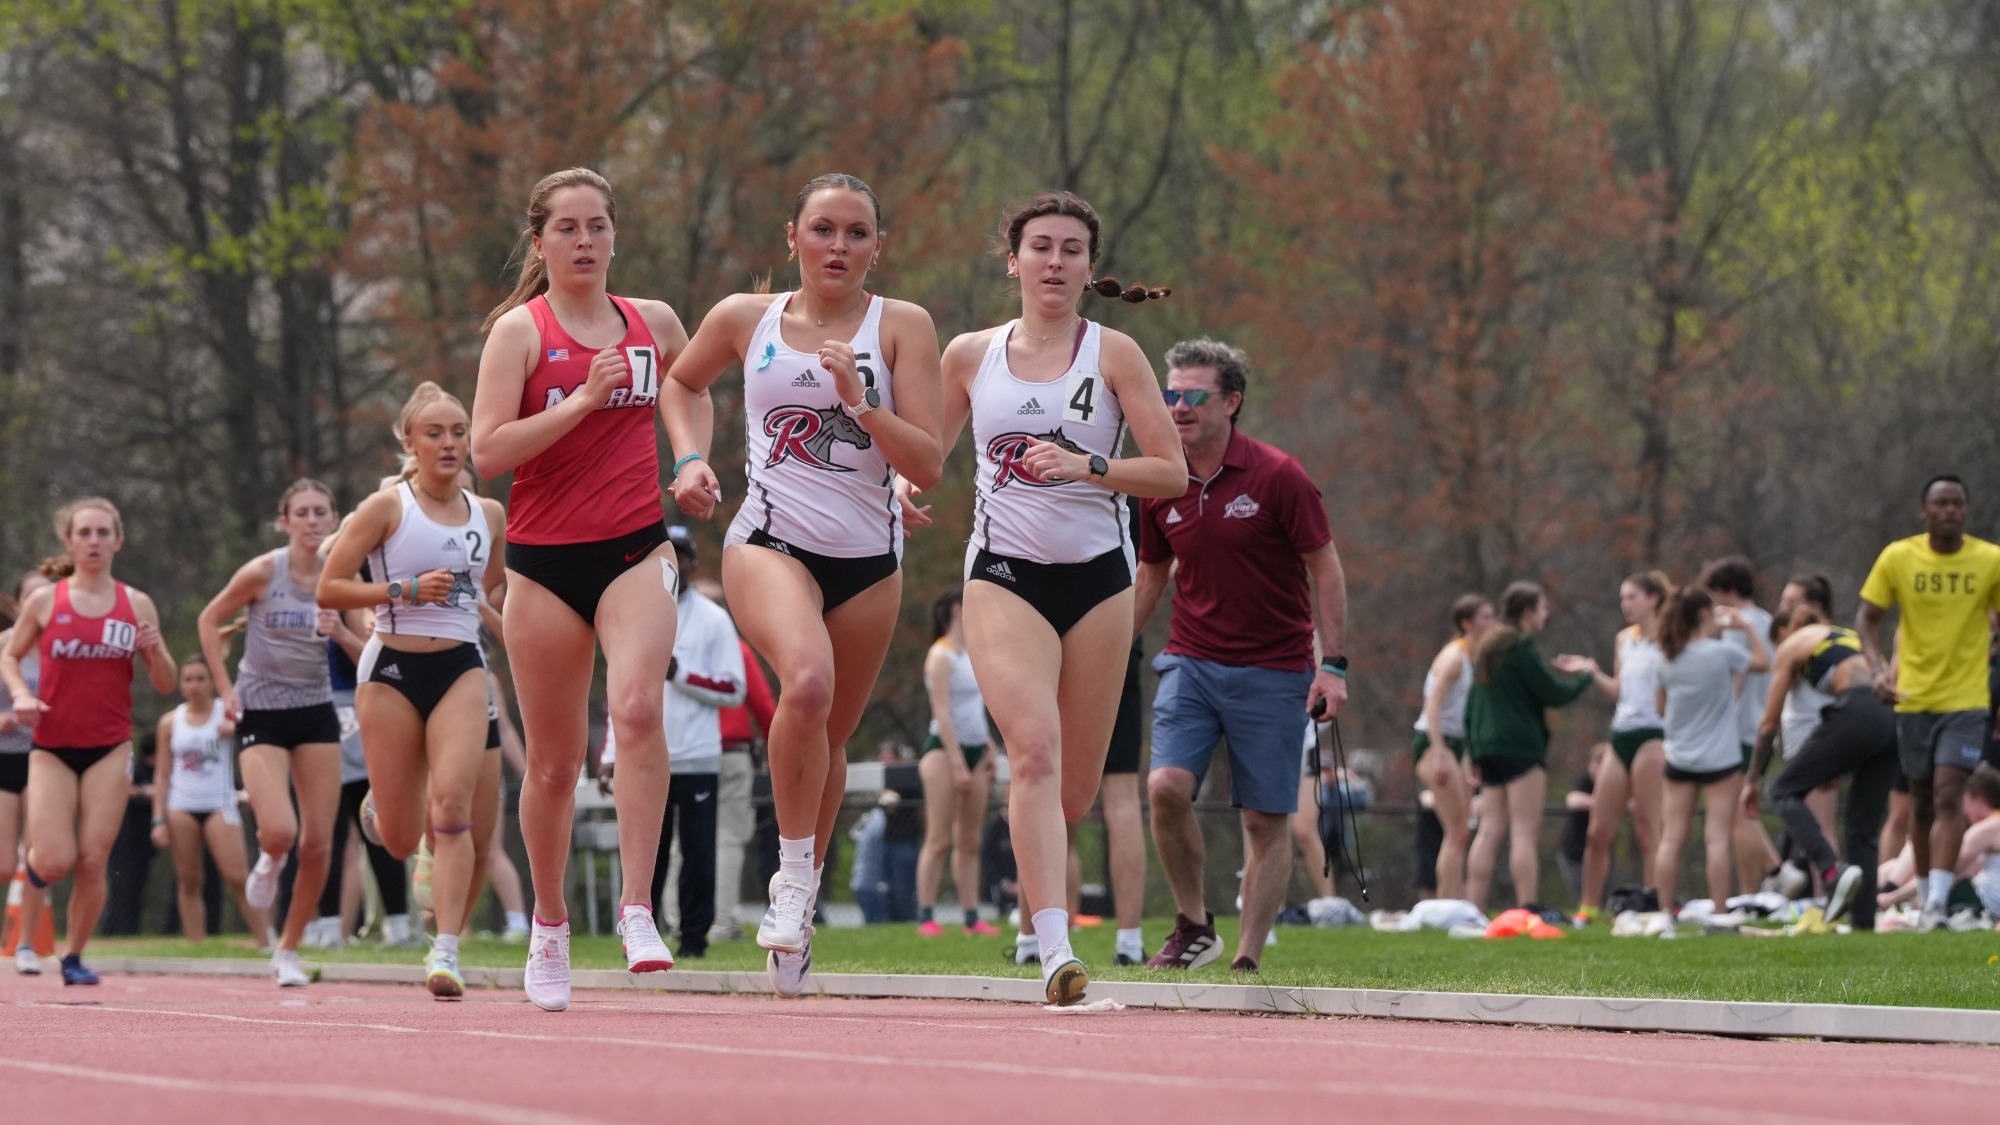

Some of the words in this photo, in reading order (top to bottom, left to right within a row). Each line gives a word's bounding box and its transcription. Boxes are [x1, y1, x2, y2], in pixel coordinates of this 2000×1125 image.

[634, 350, 652, 393] 7
[791, 380, 821, 388] adidas
[1069, 377, 1095, 421] 4
[1017, 407, 1045, 415] adidas
[466, 530, 482, 562] 2
[986, 566, 1017, 583] adidas
[1914, 572, 1976, 594] GSTC
[109, 622, 132, 647] 10
